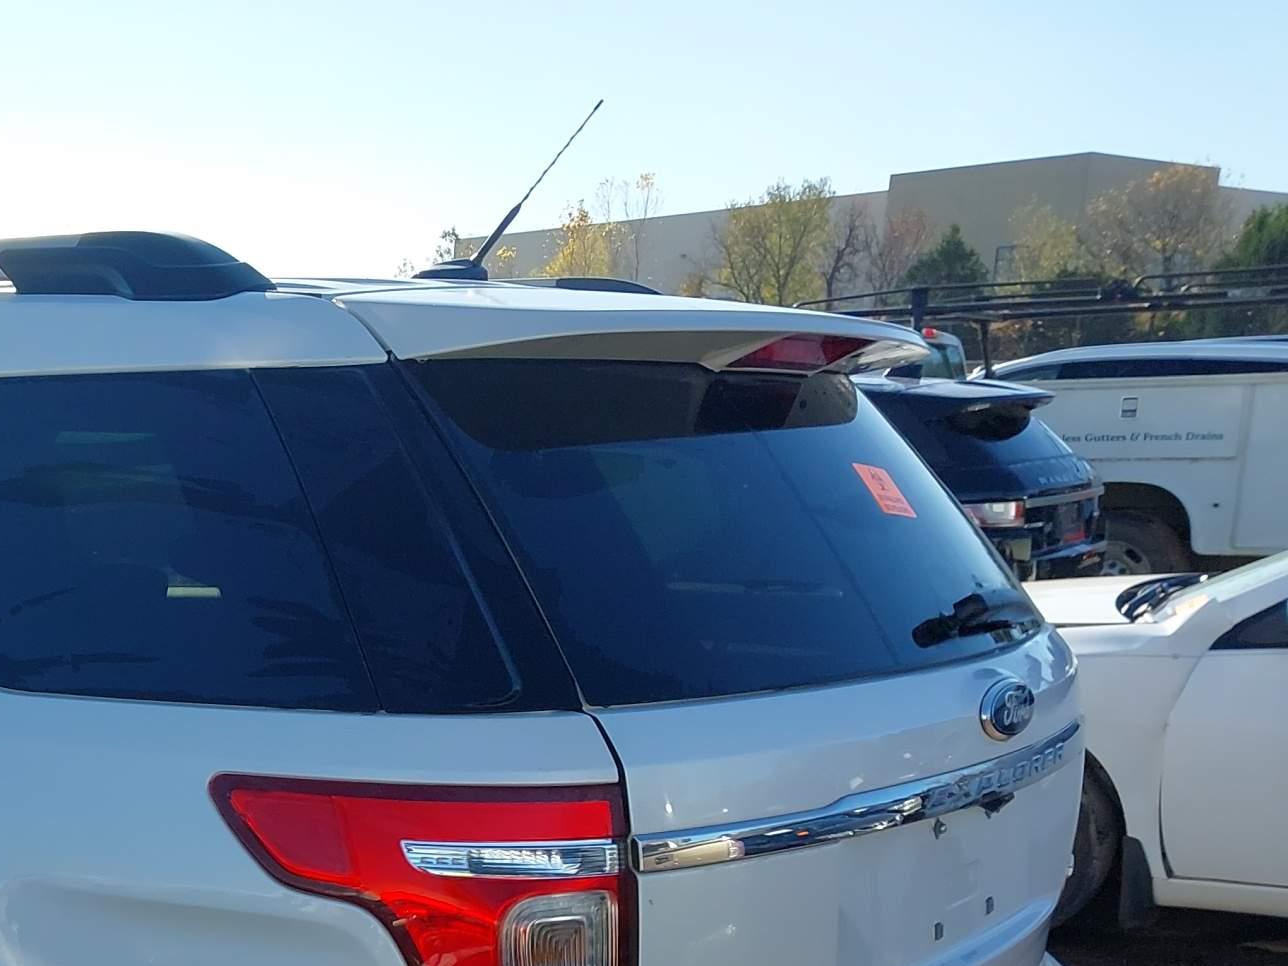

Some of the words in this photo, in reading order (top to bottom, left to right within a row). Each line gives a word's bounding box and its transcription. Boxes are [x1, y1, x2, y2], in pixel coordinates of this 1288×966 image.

[1084, 433, 1127, 442] Gutters
[1143, 432, 1182, 441] French
[1185, 431, 1224, 440] Drains
